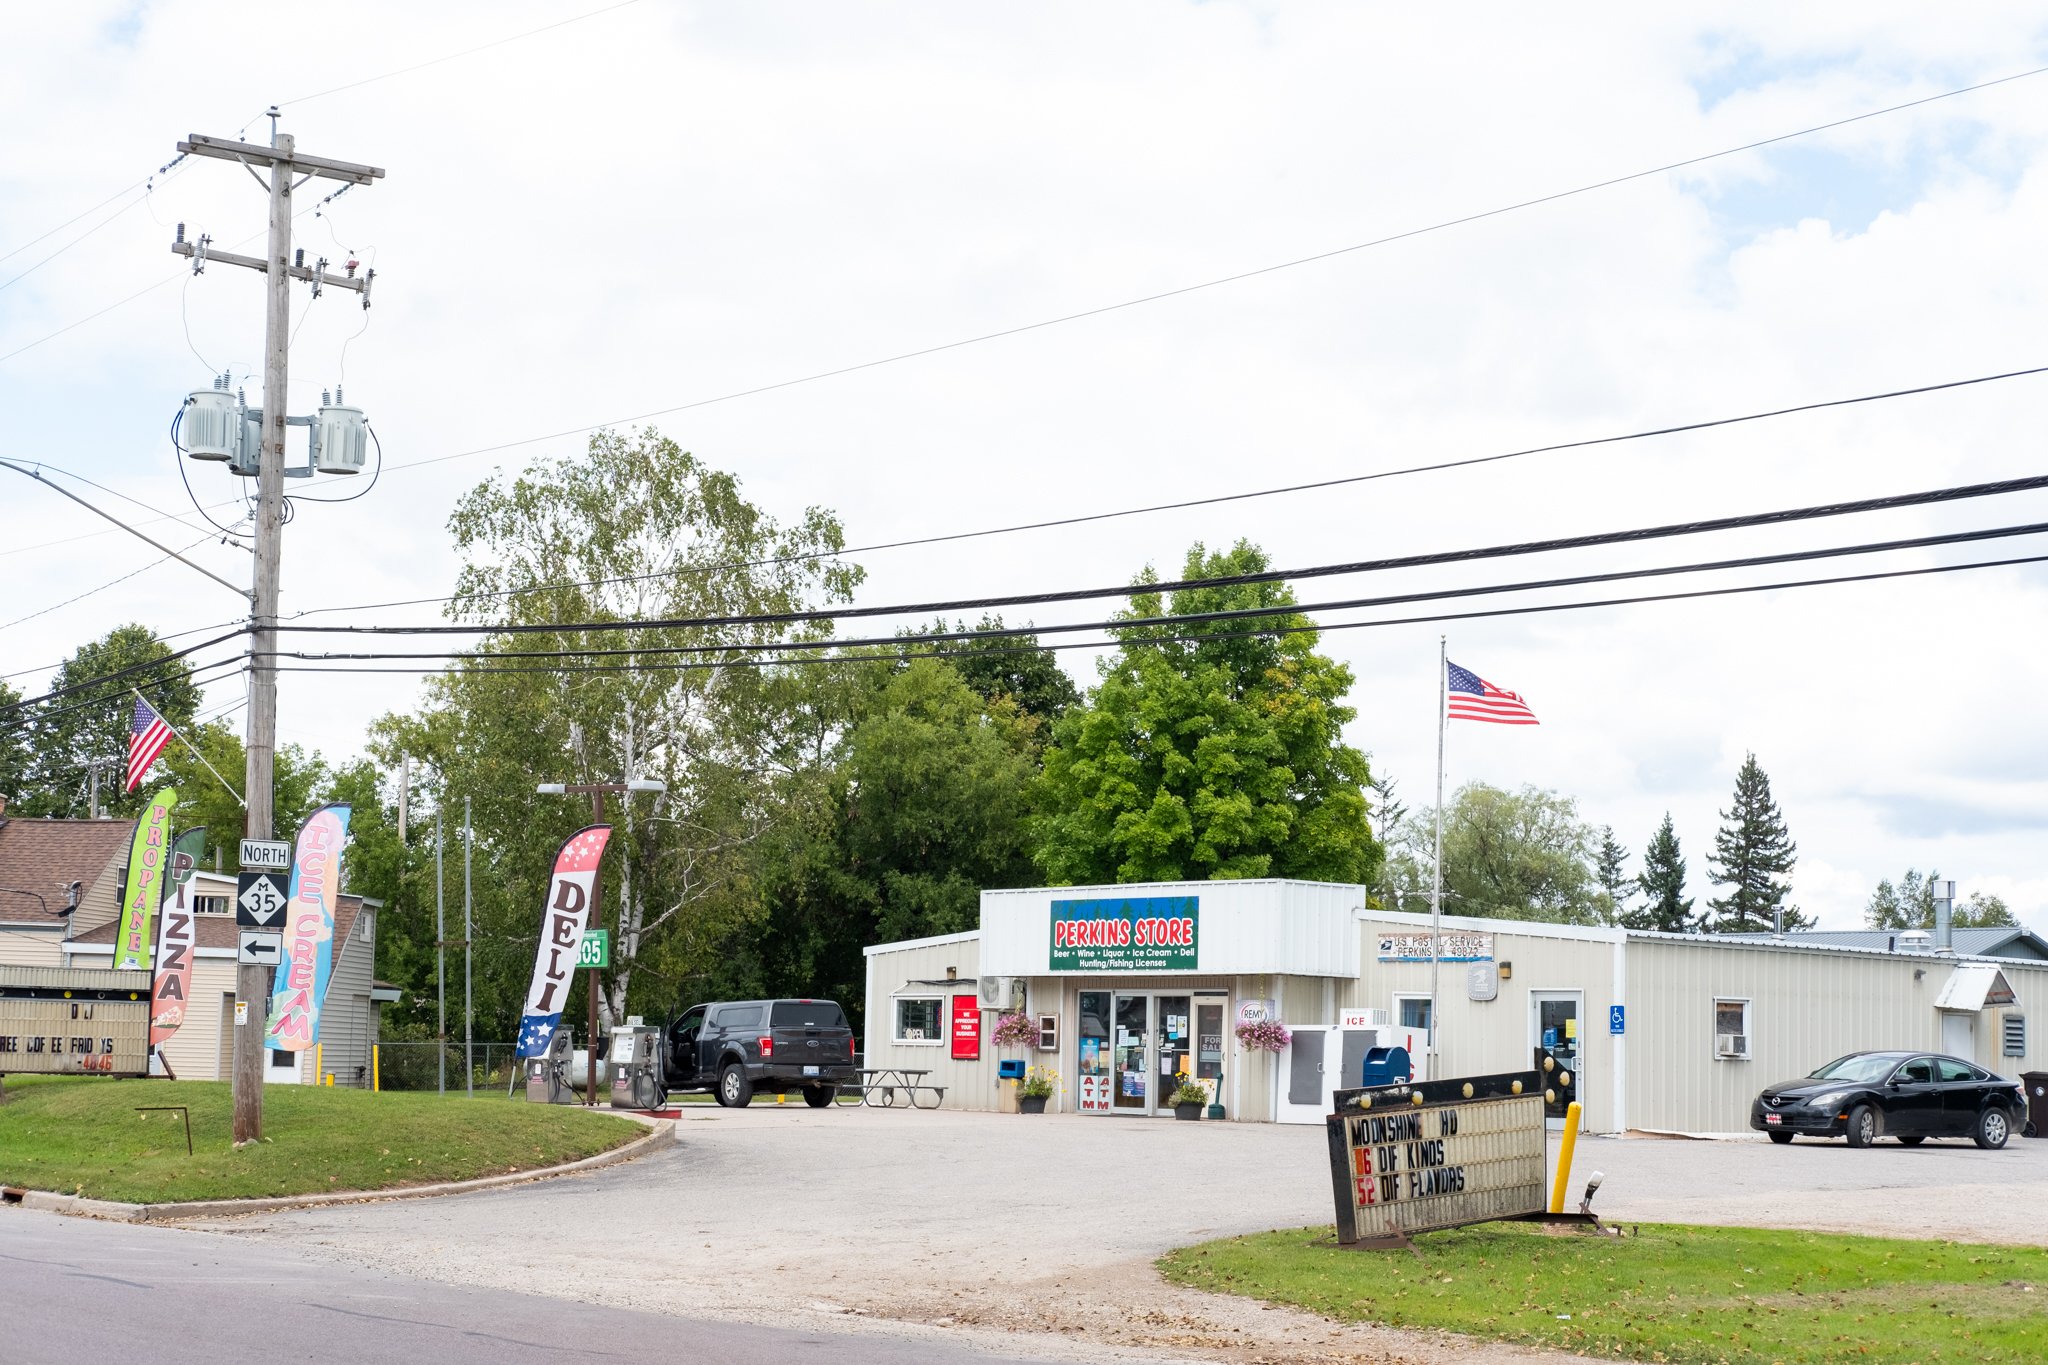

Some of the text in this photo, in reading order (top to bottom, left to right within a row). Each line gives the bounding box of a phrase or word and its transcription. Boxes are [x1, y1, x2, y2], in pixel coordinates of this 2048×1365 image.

[244, 844, 286, 863] NORTH
[127, 805, 167, 953] PROPANE
[258, 883, 269, 892] M
[249, 893, 276, 913] 35
[157, 852, 194, 1001] PIZZA
[271, 825, 329, 1041] ICE CREAM
[1055, 918, 1194, 947] PERKINS STORE
[535, 879, 586, 1013] DELI
[1413, 937, 1443, 947] POSTL
[1449, 937, 1484, 947] SERVICE
[1054, 949, 1070, 958] Beer
[1077, 949, 1095, 958] Wine
[1103, 949, 1125, 959] Liquor
[1132, 948, 1145, 957] Ice
[1146, 948, 1172, 957] Cream
[1398, 947, 1432, 957] PERKINS
[1079, 959, 1167, 969] Hunting/Fishing Licenses
[1244, 1009, 1265, 1019] REMY
[1346, 1017, 1365, 1026] ICE
[905, 1027, 925, 1039] OPEN
[1204, 1036, 1221, 1044] FOR
[1082, 1077, 1095, 1109] ATM
[1098, 1077, 1110, 1109] ATM
[1379, 1144, 1398, 1172] DIF
[1406, 1139, 1445, 1169] KINDS
[1356, 1165, 1465, 1205] 52 DIF FLAVORS
